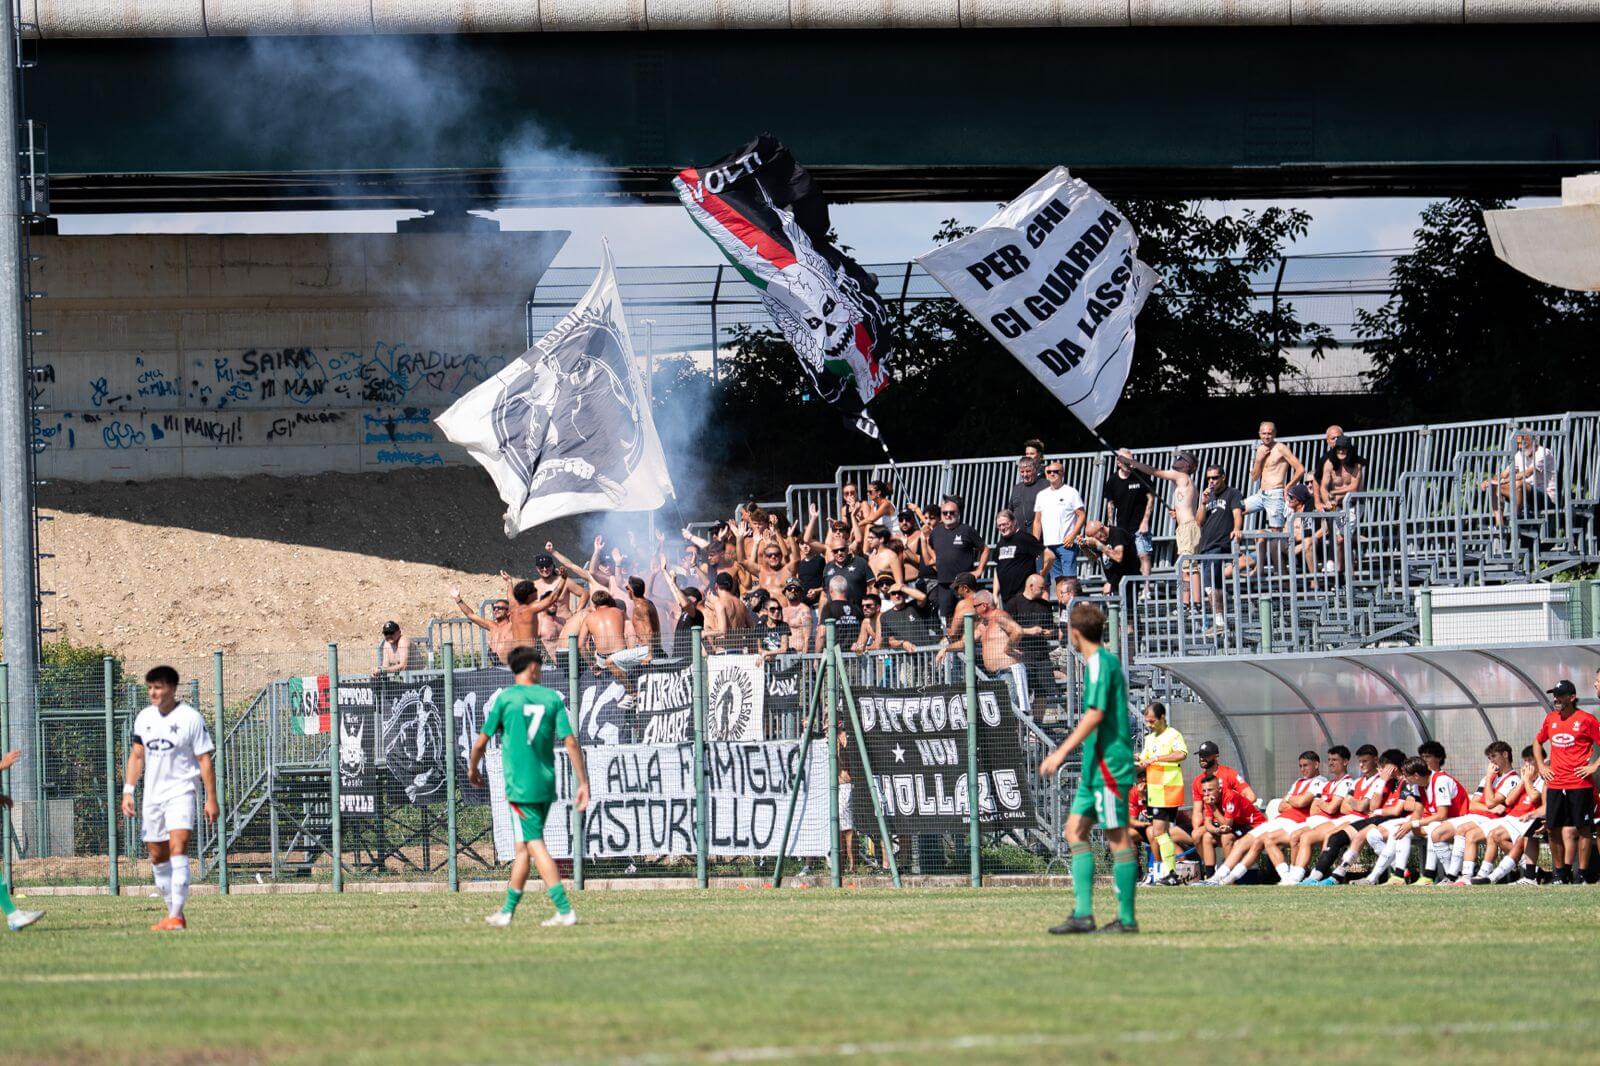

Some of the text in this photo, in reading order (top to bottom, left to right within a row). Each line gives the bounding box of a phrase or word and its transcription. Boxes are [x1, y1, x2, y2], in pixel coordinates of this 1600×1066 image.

[686, 152, 763, 203] VOLTI
[966, 198, 1071, 291] PER CHI
[990, 209, 1122, 339] CI GUARDA
[1037, 338, 1086, 377] DA
[163, 415, 242, 444] MI MANCHI!
[638, 664, 694, 711] GIORNAT
[523, 704, 545, 744] 7
[642, 707, 690, 744] AMARE
[607, 749, 662, 793] ALLA
[676, 741, 806, 795] FAMIGLIA
[915, 738, 959, 765] NON
[340, 795, 374, 813] STILE
[872, 769, 1022, 816] MOLLARE
